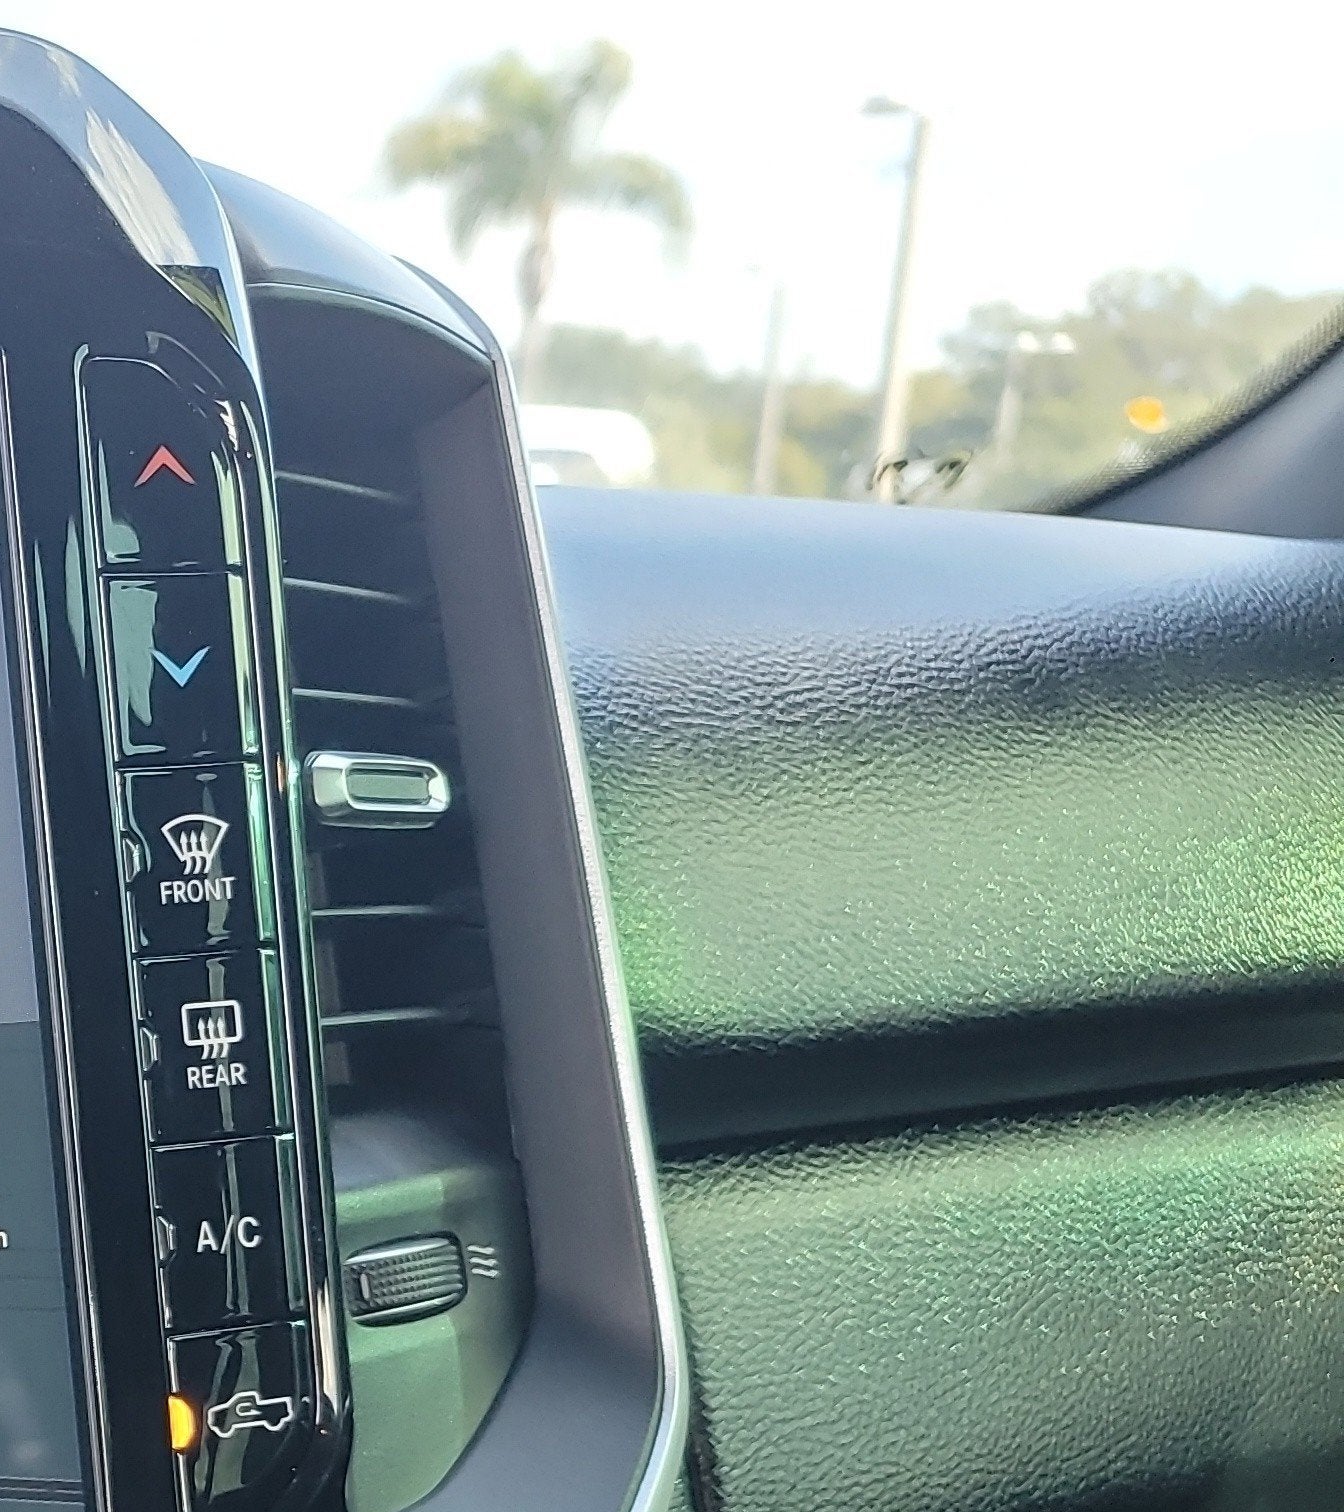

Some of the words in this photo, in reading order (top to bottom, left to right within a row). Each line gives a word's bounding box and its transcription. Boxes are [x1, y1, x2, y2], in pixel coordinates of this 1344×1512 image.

[159, 875, 236, 905] FRONT
[186, 1062, 248, 1090] REAR
[197, 1214, 263, 1254] A/C
